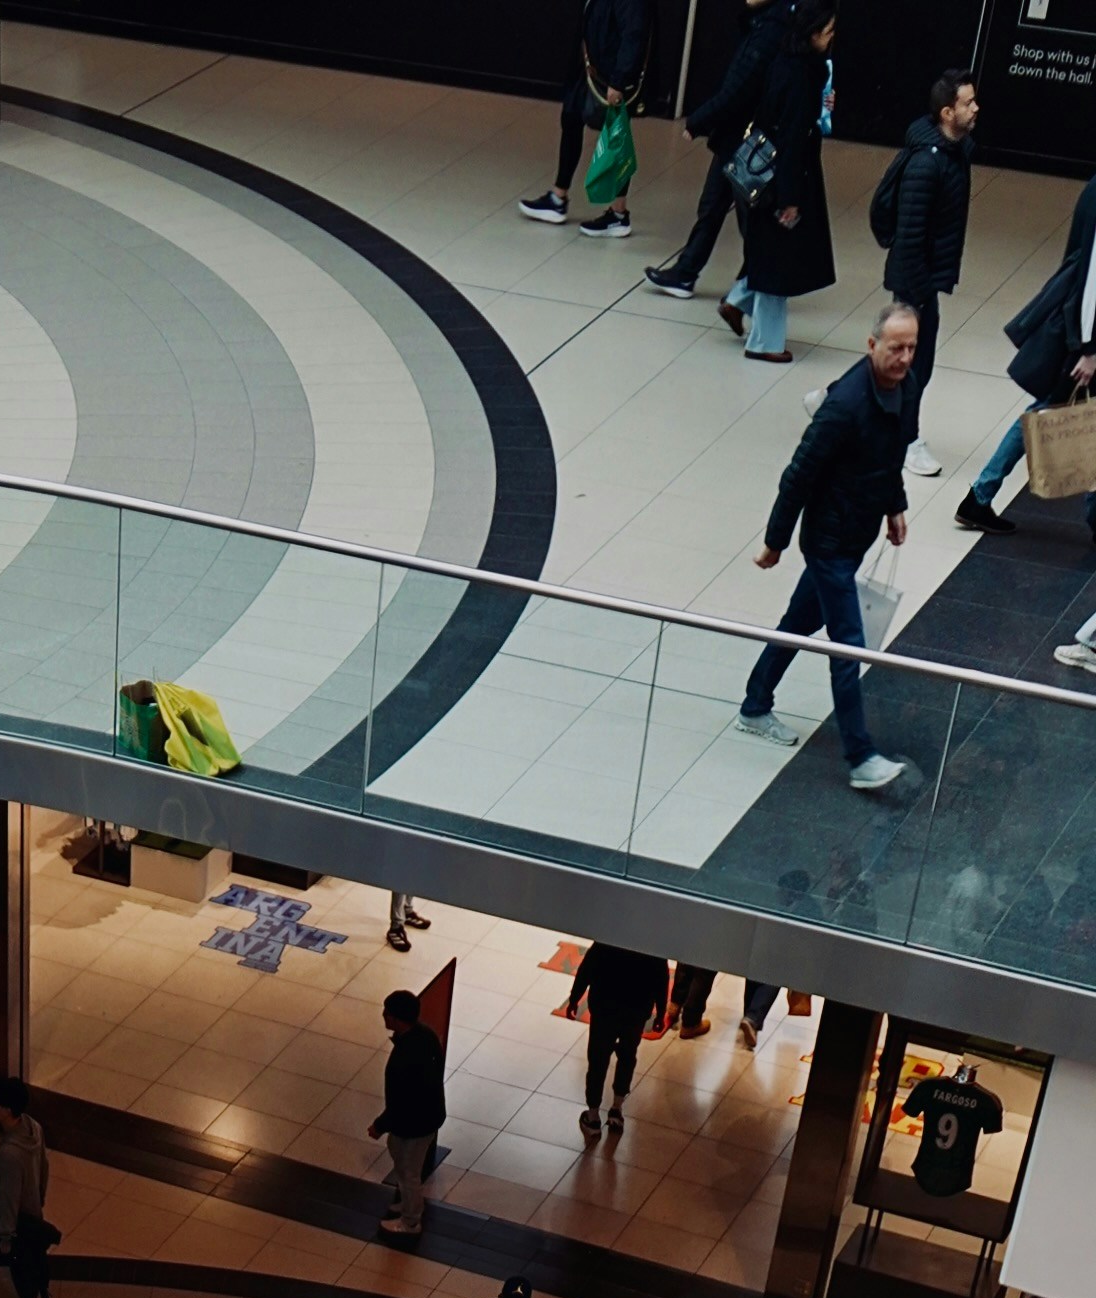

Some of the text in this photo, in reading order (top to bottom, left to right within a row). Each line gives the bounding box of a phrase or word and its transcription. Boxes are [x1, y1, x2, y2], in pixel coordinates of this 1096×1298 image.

[1009, 62, 1043, 78] down
[1046, 67, 1066, 80] the
[1013, 44, 1044, 62] Shop
[1047, 50, 1074, 63] with
[1076, 55, 1090, 66] us
[209, 884, 312, 921] ARG
[199, 926, 286, 964] INA
[241, 915, 349, 953] ENT
[935, 1113, 959, 1150] 9
